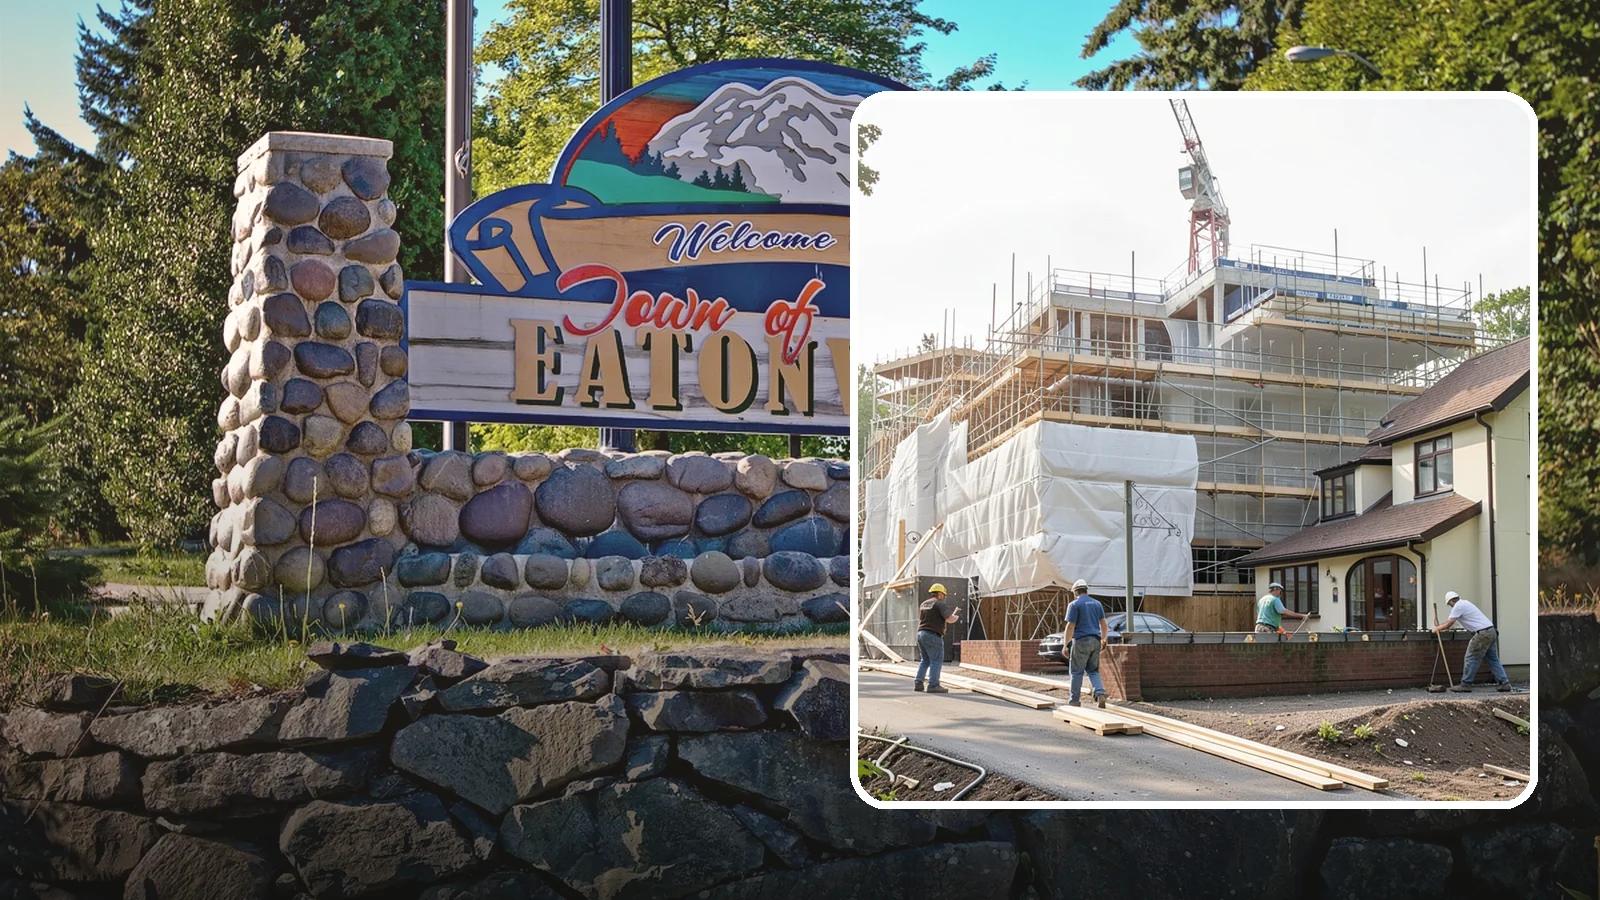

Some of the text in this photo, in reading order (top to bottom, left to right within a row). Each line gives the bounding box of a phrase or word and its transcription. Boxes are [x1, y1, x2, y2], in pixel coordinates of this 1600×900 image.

[653, 220, 837, 263] Welcome
[556, 263, 826, 365] Town of
